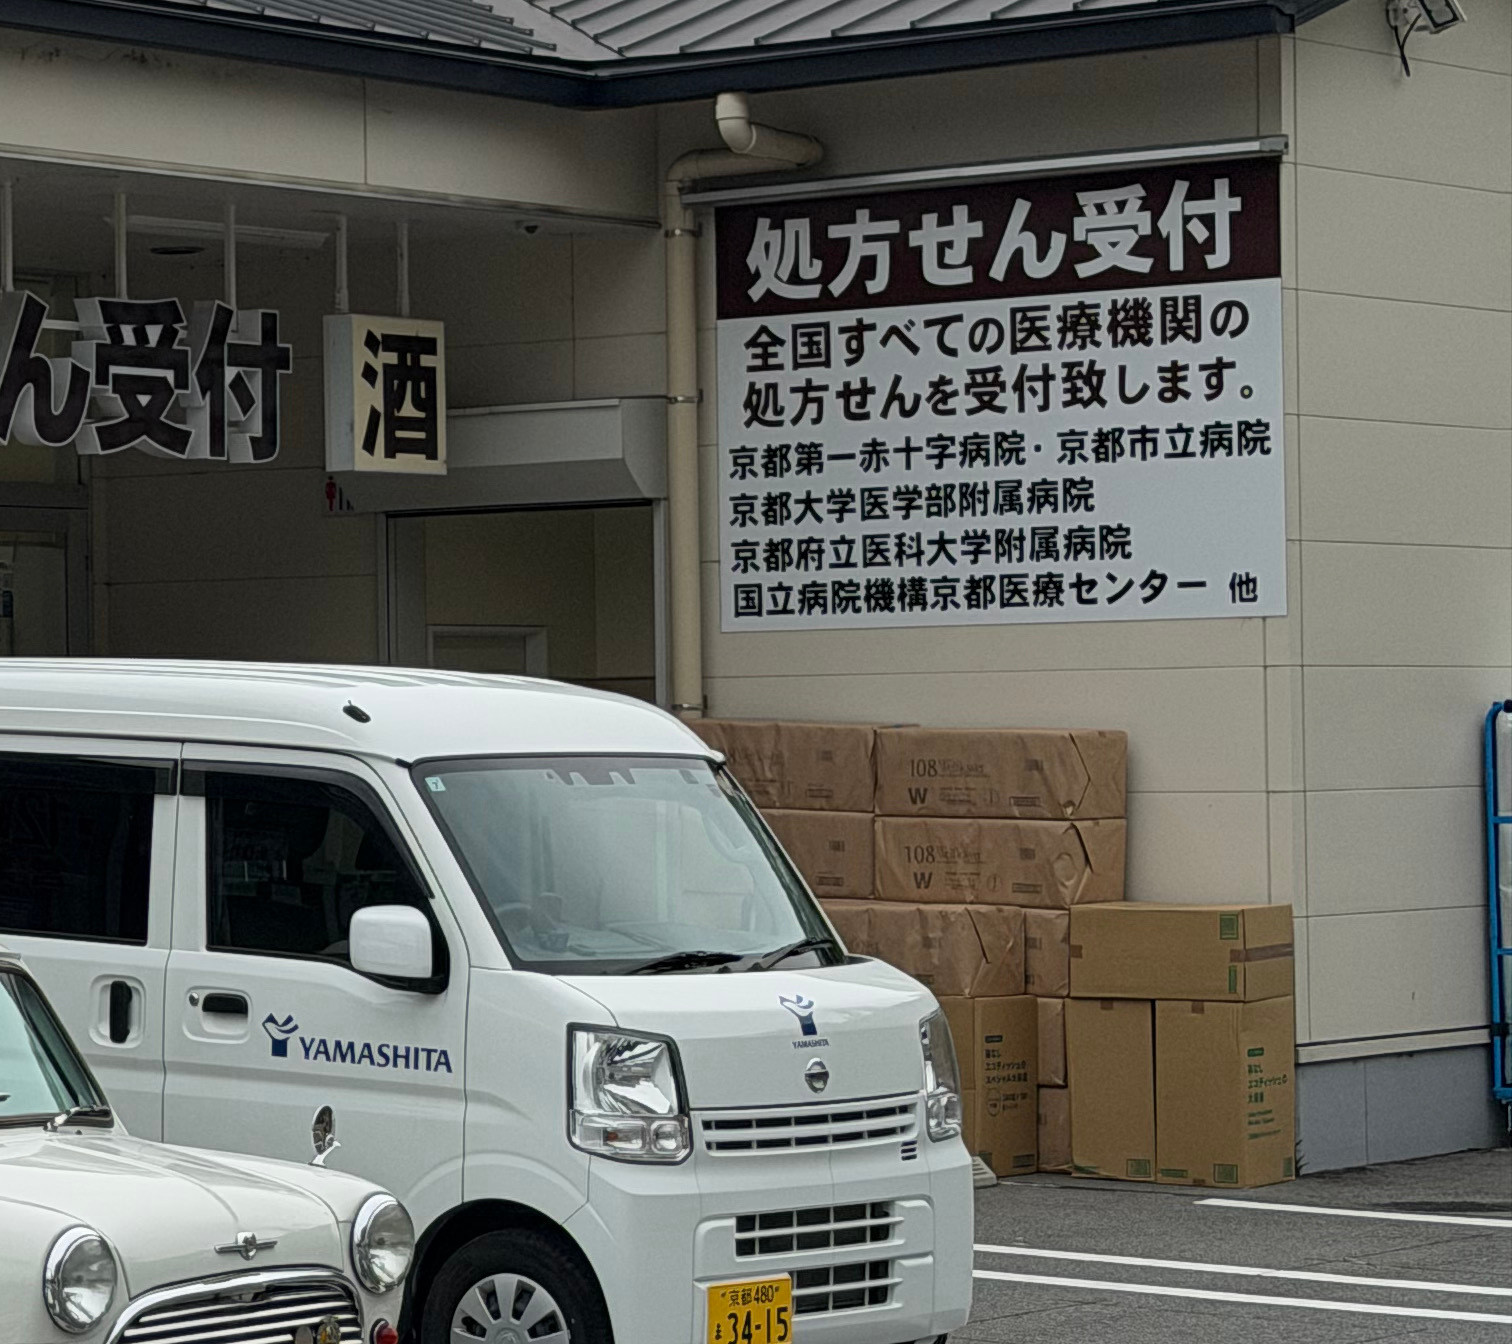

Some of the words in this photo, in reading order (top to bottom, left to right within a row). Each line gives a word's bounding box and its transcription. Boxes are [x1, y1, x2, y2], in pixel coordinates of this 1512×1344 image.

[745, 177, 1242, 303] 処方せん受付
[743, 294, 1250, 374] 全国すべての医療機関の
[361, 329, 439, 460] 酒
[741, 356, 1255, 429] 処方せんを受付致します。
[728, 477, 1095, 527] 京都大学医学部附属病院
[730, 524, 1132, 574] 京都府立医科大学附属病院
[733, 569, 1207, 619] 国立病院機構京都医療センター
[1229, 571, 1259, 604] 他
[910, 758, 938, 778] 108
[908, 787, 928, 805] W
[904, 845, 936, 864] 108
[913, 872, 932, 889] W
[299, 1034, 454, 1074] YAMASHITA
[792, 1038, 829, 1050] YAMASHITA
